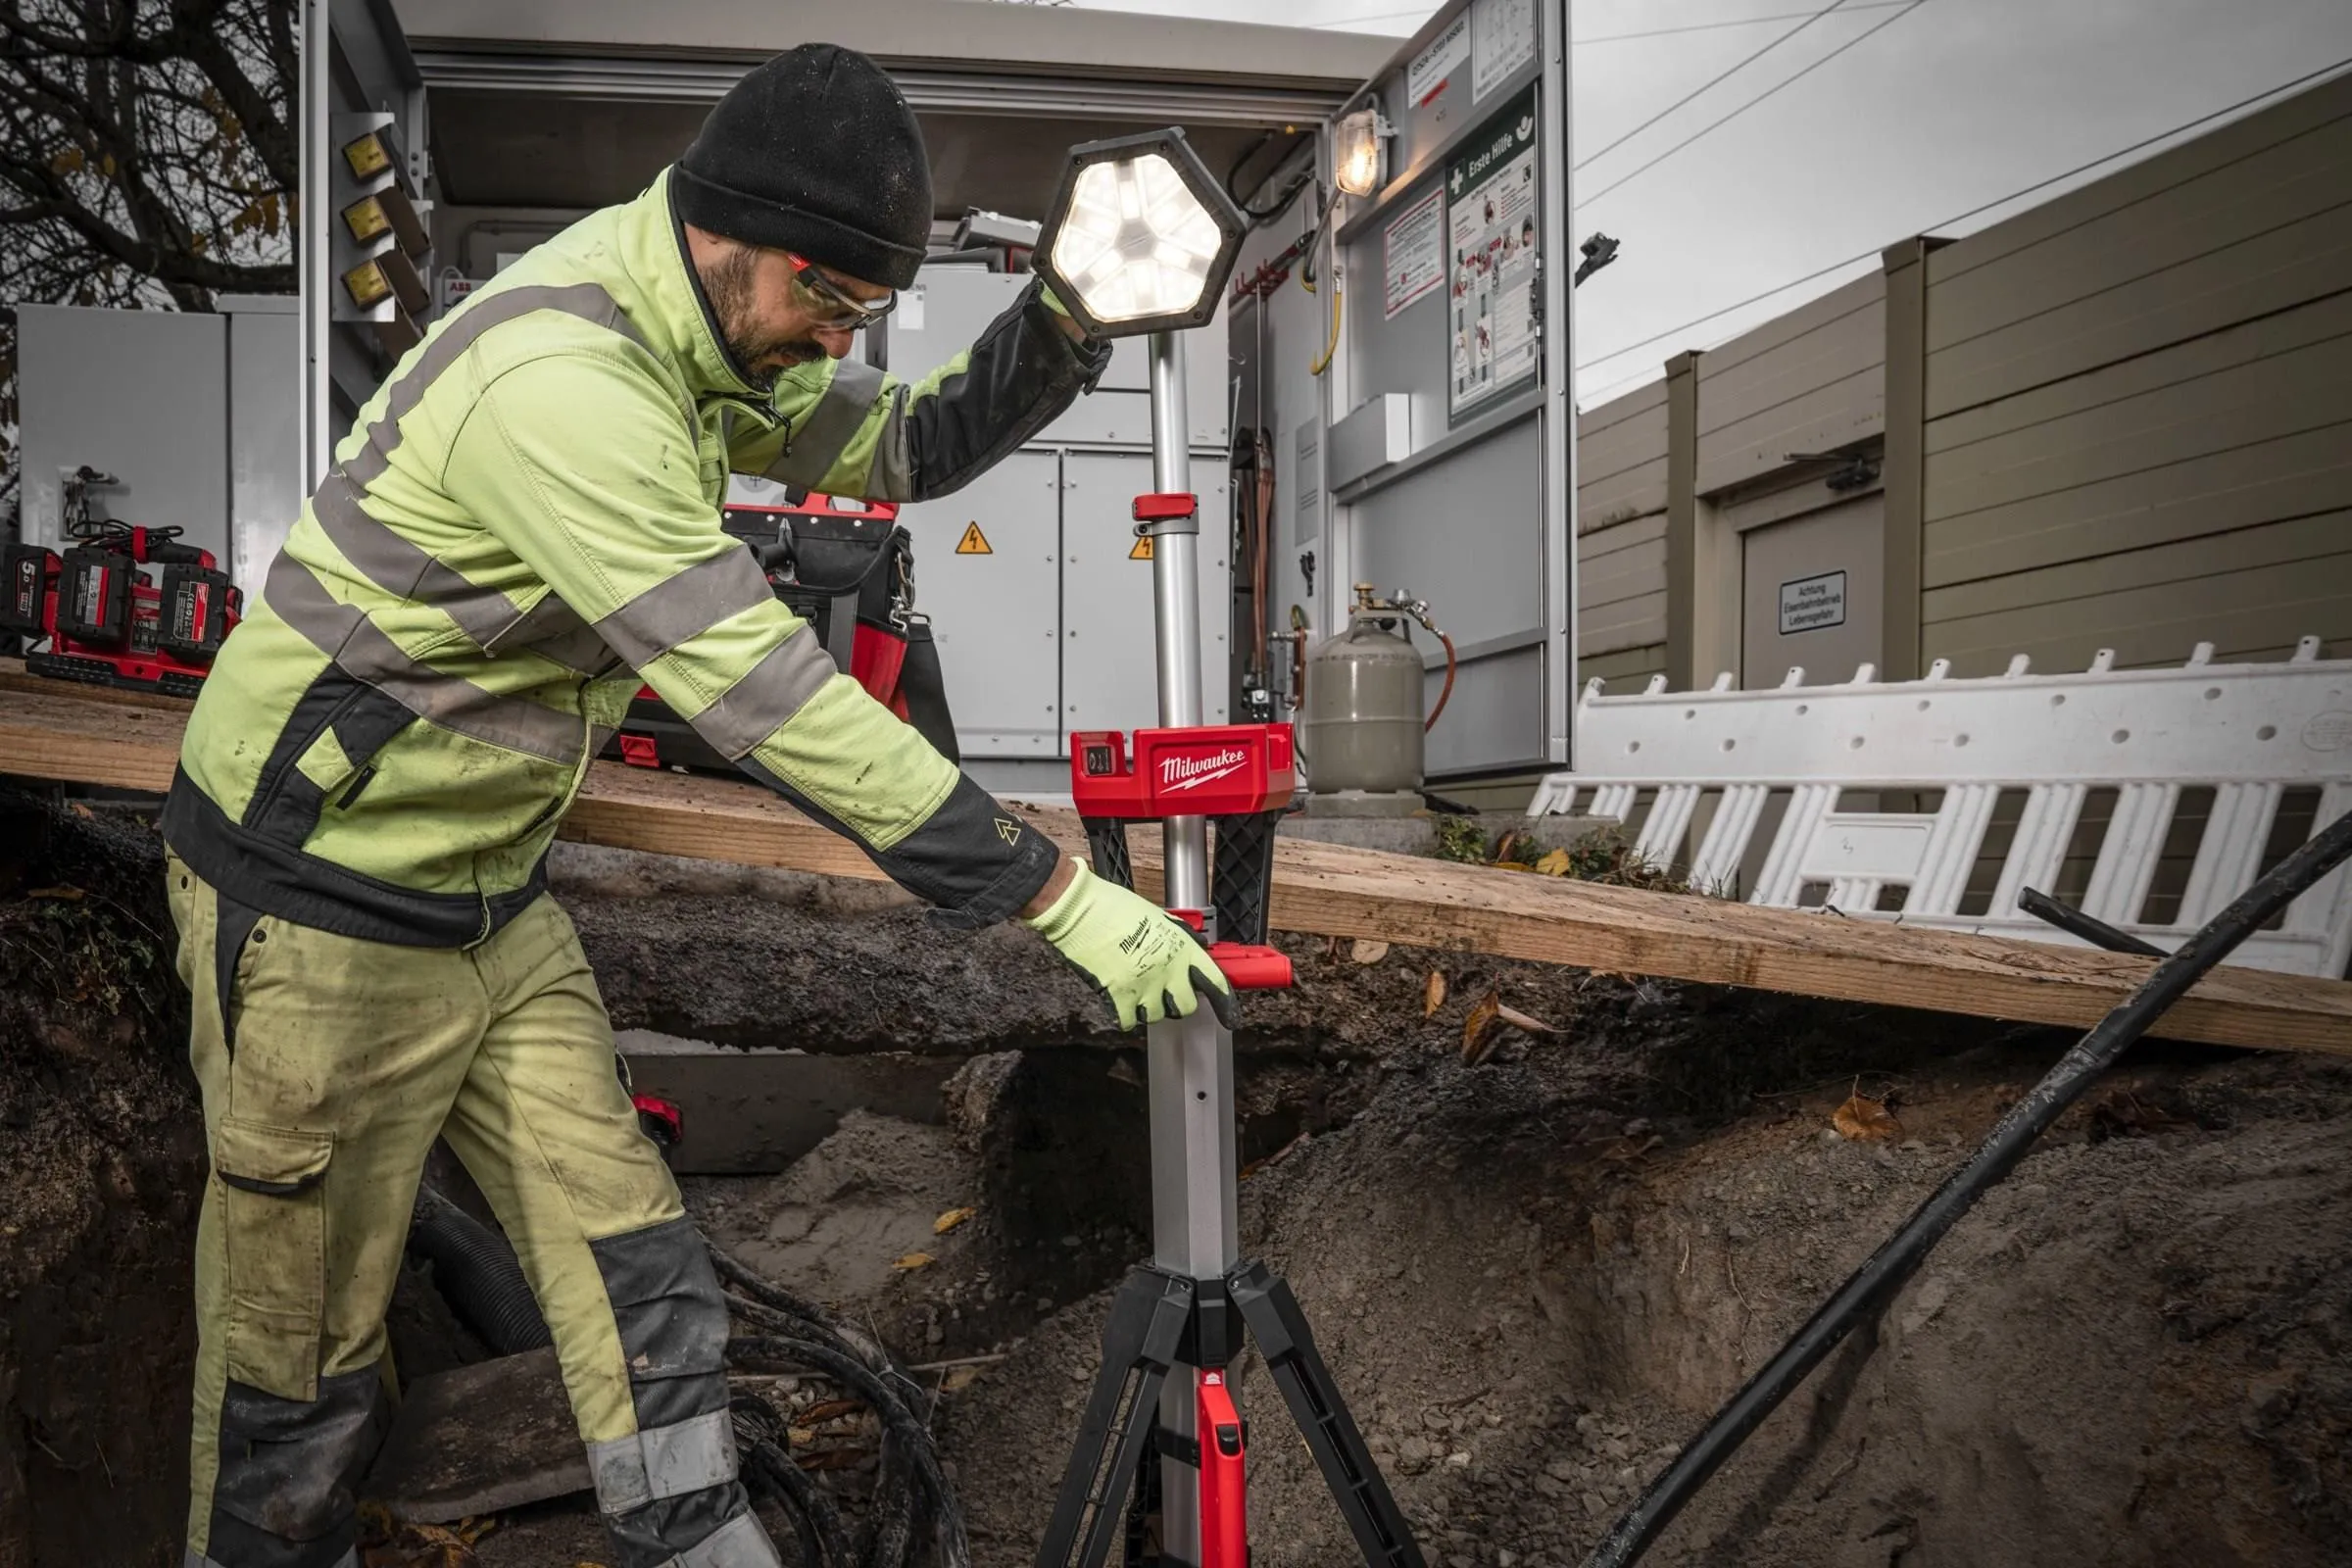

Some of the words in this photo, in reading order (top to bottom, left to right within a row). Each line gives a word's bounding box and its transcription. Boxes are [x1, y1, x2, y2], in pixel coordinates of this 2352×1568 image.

[1468, 152, 1491, 178] Erste
[1492, 132, 1513, 161] Hilfe
[450, 281, 471, 292] ABB
[1798, 584, 1827, 597] Achtung
[1784, 593, 1841, 614] Eisenbahnbetrieb
[1788, 609, 1835, 626] Lebensgefahr
[1158, 748, 1247, 784] Milwaukee
[1119, 916, 1150, 955] Milwaukee
